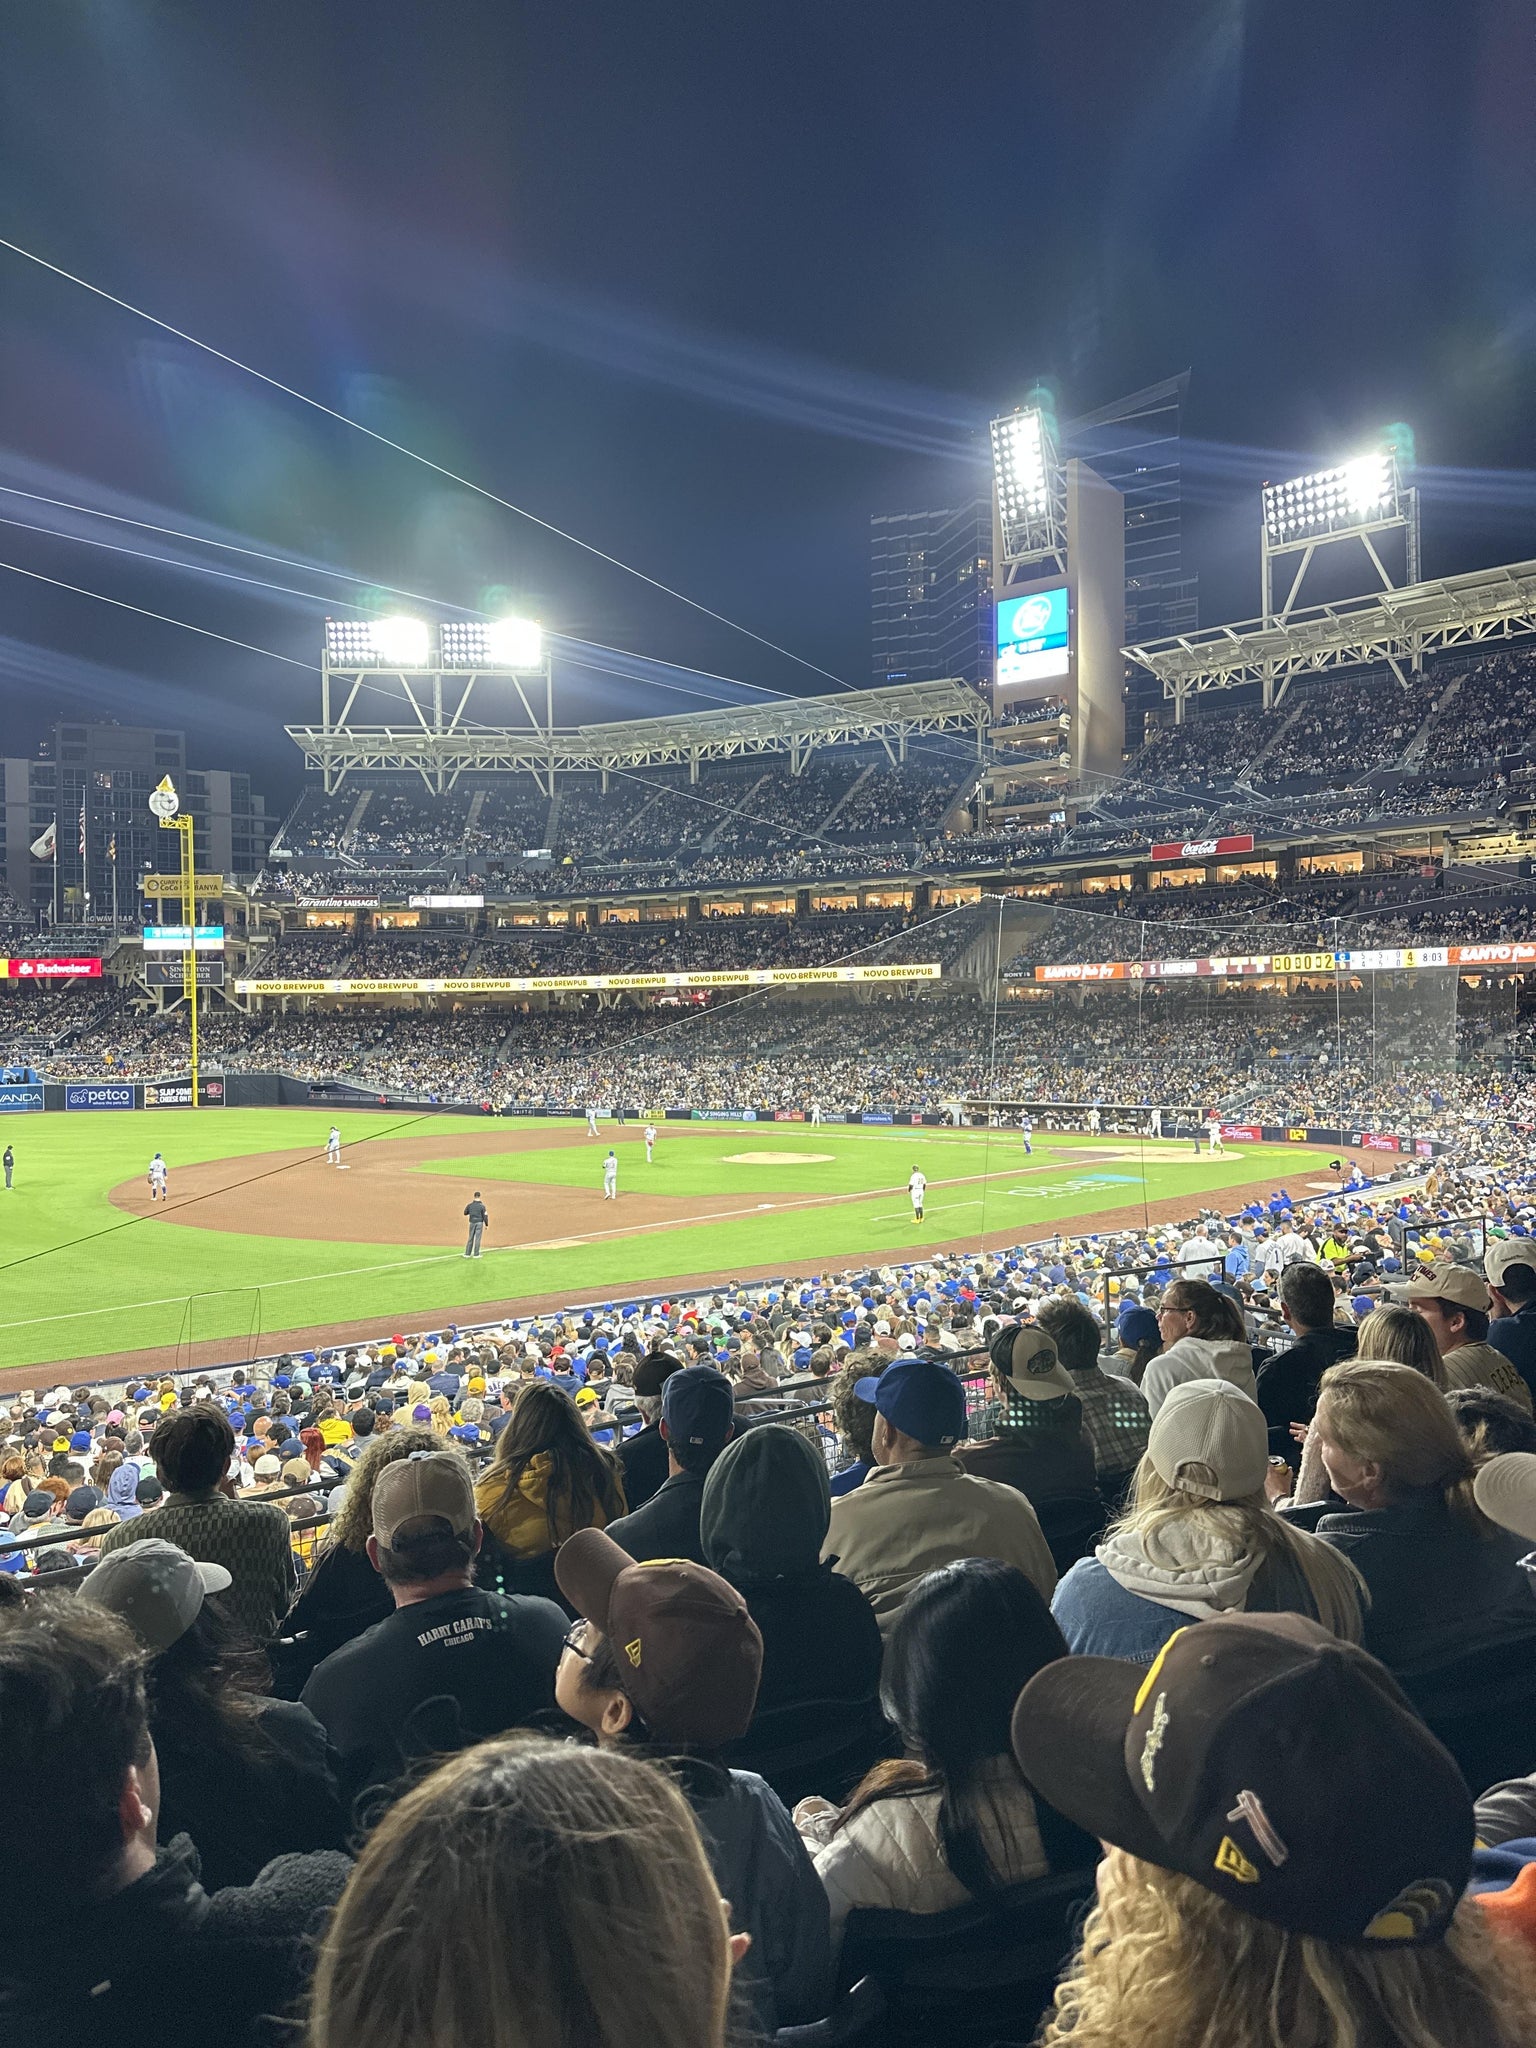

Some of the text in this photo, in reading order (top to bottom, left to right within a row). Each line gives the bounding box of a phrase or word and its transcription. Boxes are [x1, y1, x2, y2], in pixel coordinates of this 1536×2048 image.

[1182, 840, 1219, 856] Coca-Cola
[297, 896, 378, 907] Tarantino SAUSAGES
[1407, 952, 1413, 962] 4
[1423, 953, 1442, 962] 8:03
[1460, 946, 1511, 960] SANYO
[36, 964, 92, 974] Budweiser
[891, 968, 933, 976] BREWPUB
[88, 1089, 130, 1104] petco
[160, 1088, 175, 1096] SLAP
[1491, 1365, 1524, 1394] CEAS
[417, 1617, 492, 1647] HARRY CARAY'S
[444, 1632, 475, 1647] CHICAGO
